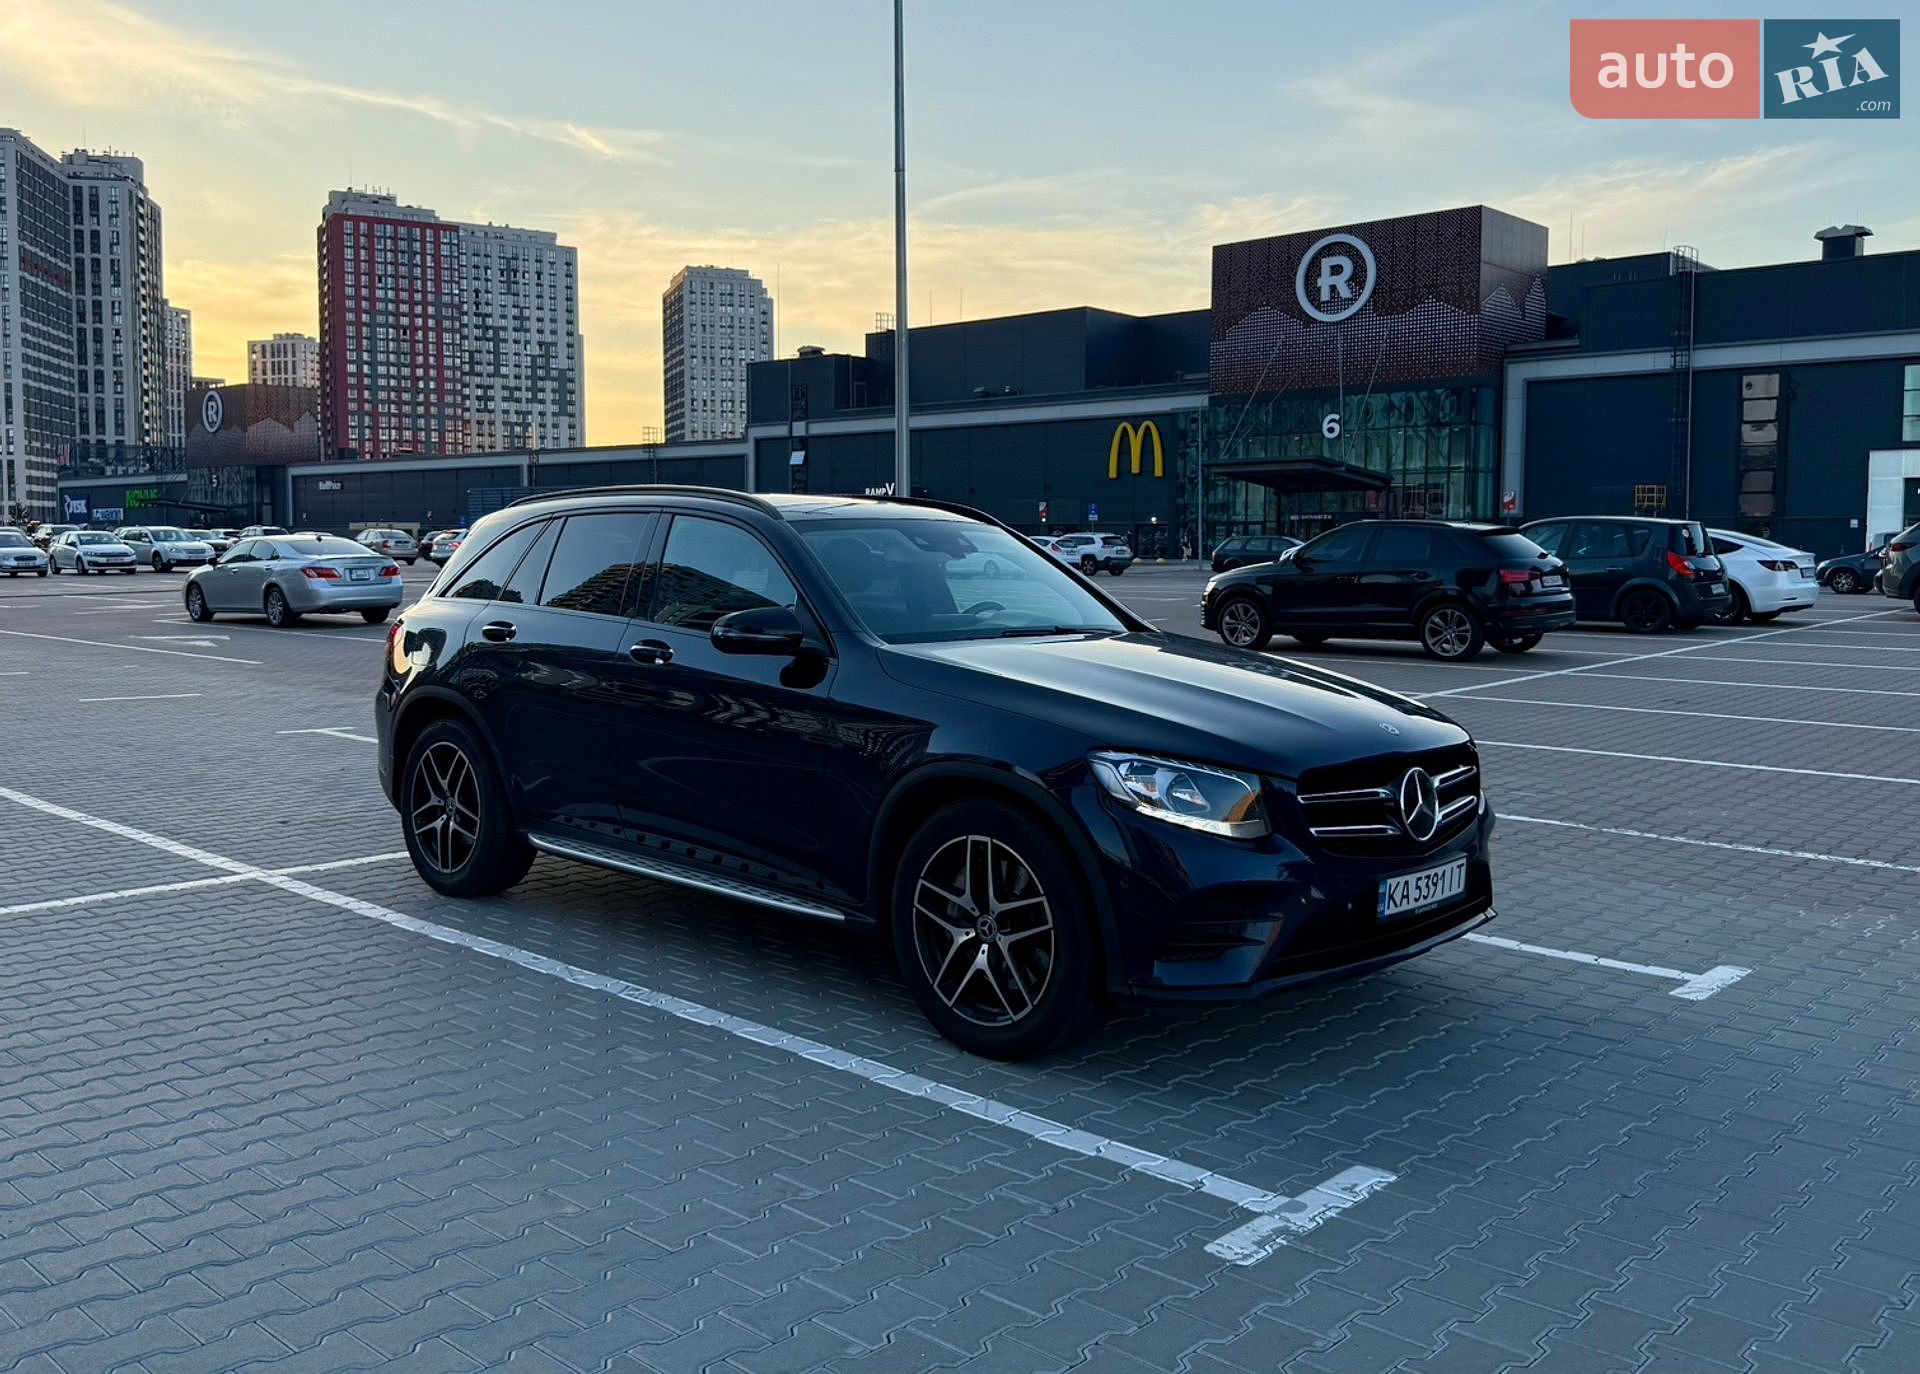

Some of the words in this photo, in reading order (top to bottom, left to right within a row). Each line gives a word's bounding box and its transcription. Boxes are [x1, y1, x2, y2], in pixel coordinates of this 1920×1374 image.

[1321, 413, 1342, 439] 6
[1387, 879, 1410, 910] KA
[1413, 869, 1446, 903] 5391
[1449, 863, 1465, 892] IT
